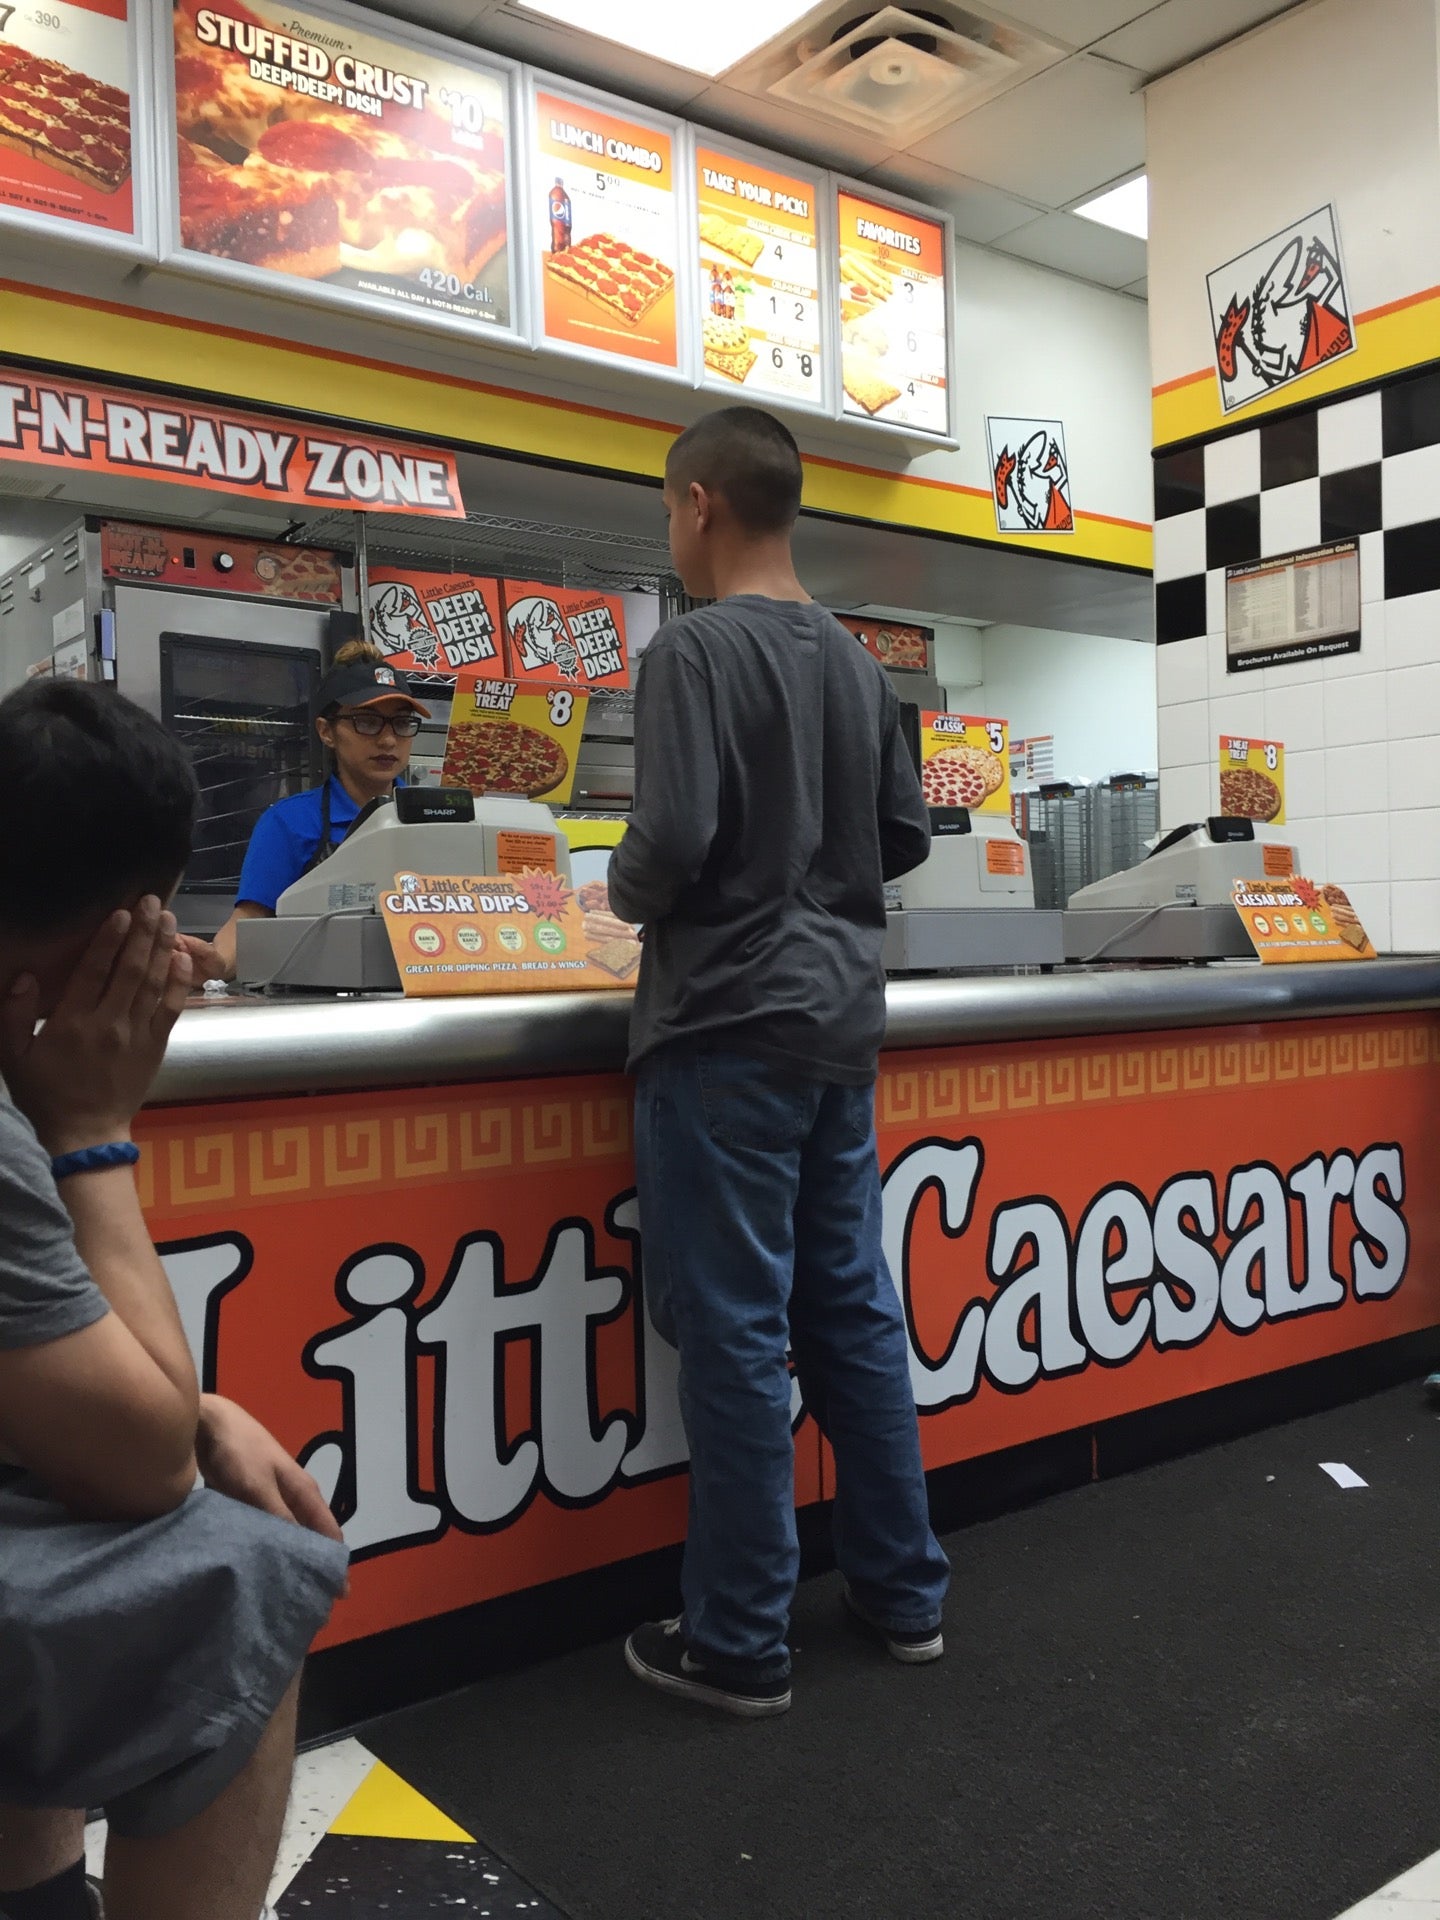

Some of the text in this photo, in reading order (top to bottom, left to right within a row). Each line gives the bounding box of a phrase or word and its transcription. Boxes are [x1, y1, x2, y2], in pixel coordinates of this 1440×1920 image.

[35, 10, 60, 29] 390
[289, 20, 345, 51] Premium
[196, 9, 428, 110] STUFFED CRUST
[345, 89, 383, 118] DISH
[550, 118, 662, 174] LUNCH COMBO
[702, 166, 809, 220] TAKE YOUR PICK!
[856, 216, 920, 256] FAVORITES
[774, 244, 783, 261] 4
[397, 289, 410, 300] ALL
[411, 293, 425, 303] DAY
[419, 267, 493, 304] 420 Cal.
[769, 296, 804, 321] 1 2
[771, 347, 783, 369] 6
[907, 381, 915, 397] 4
[305, 437, 456, 510] ZONE
[1295, 547, 1334, 563] Information
[1335, 543, 1355, 553] Guide
[421, 580, 475, 599] Little Caesars
[426, 589, 485, 623] DEEP!
[562, 597, 605, 615] Little Caesars
[435, 611, 493, 645] DEEP!
[567, 606, 613, 638] DEEP!
[443, 634, 497, 668] DISH
[575, 627, 621, 659] DEEP!
[1237, 641, 1349, 666] Brochures Available On Request
[582, 649, 624, 680] DISH
[474, 679, 517, 698] 3 MEAT
[475, 693, 512, 711] TREAT
[546, 688, 574, 727] $8
[932, 719, 966, 735] CLASSIC
[1230, 748, 1247, 761] TREAT
[1232, 739, 1249, 751] MEAT
[423, 808, 456, 816] SHARP
[422, 878, 514, 894] Little Caesars
[386, 894, 478, 914] CAESAR
[481, 894, 531, 914] DIPS
[1235, 893, 1277, 907] CAESAR
[1277, 893, 1304, 907] DIPS
[405, 965, 434, 974] GREAT
[436, 964, 454, 973] FOR
[456, 963, 491, 973] DIPPING
[521, 961, 548, 970] BREAD
[550, 961, 556, 969] &
[558, 960, 588, 969] WINGS!
[882, 1136, 1412, 1415] Caesars
